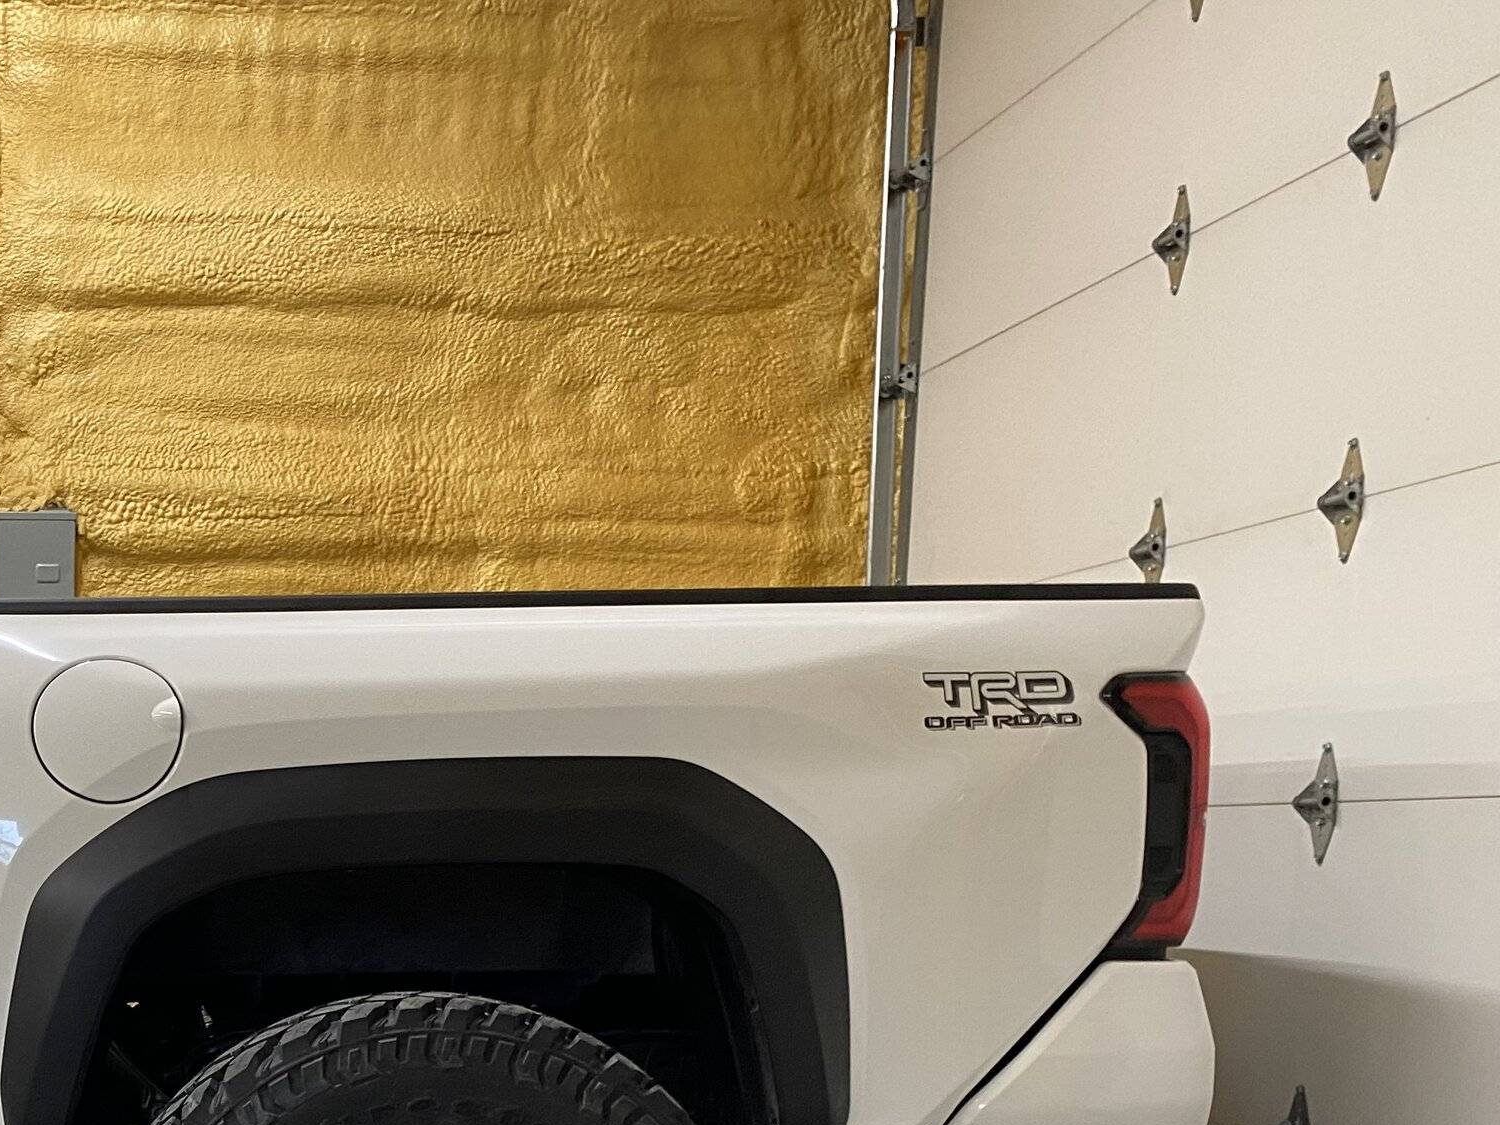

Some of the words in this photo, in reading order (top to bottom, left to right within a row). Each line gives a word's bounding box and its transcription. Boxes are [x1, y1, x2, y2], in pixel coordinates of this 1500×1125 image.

[922, 671, 1075, 716] TRD
[924, 714, 988, 731] OFF
[992, 711, 1083, 730] ROAD
